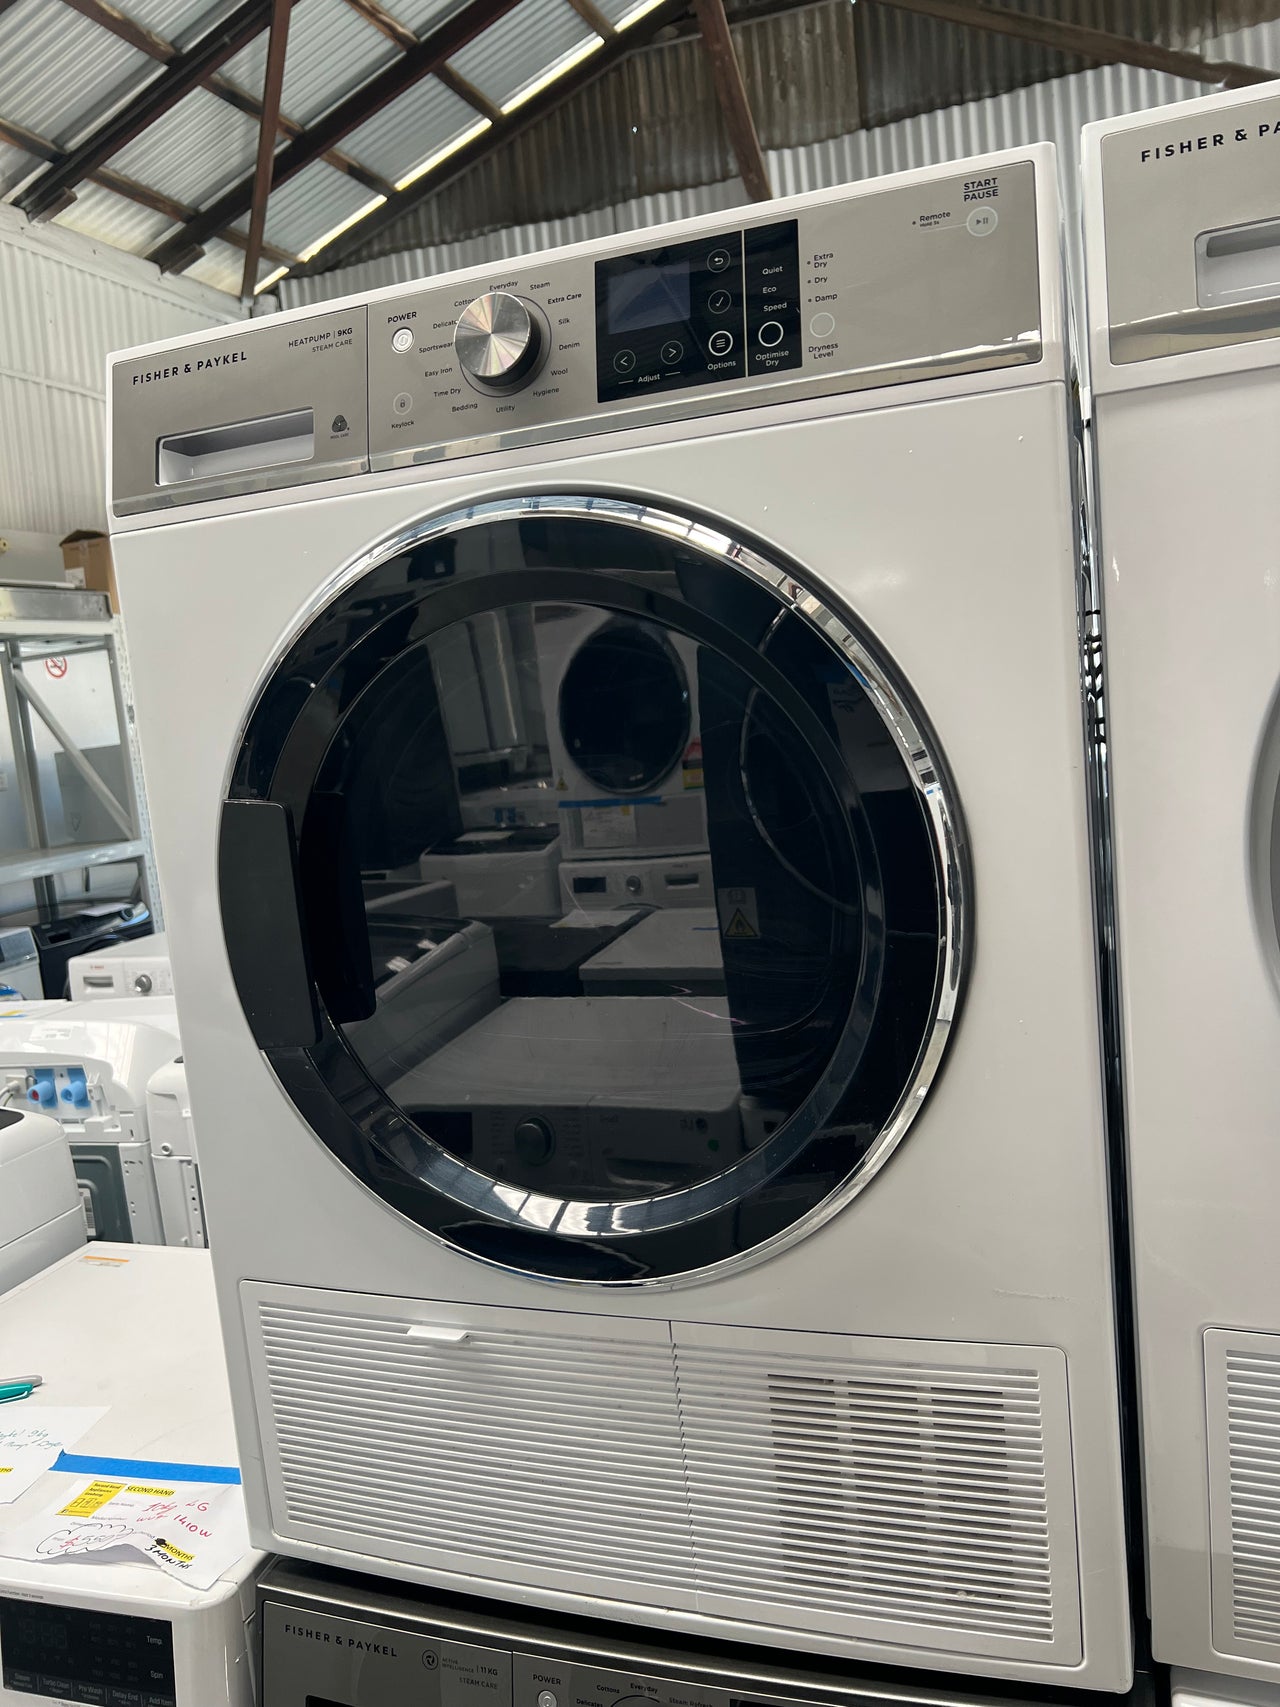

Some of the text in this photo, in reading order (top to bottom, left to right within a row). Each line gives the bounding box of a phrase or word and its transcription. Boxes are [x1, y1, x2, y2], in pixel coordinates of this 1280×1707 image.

[1141, 134, 1224, 162] FISHER
[1235, 129, 1248, 142] &
[964, 178, 998, 190] START
[964, 189, 999, 202] PAUSE
[920, 212, 951, 222] Remote
[814, 252, 834, 261] Extra
[814, 260, 828, 269] Dry
[762, 265, 784, 276] Quiet
[815, 275, 828, 284] Dry
[489, 280, 519, 292] Everyday
[529, 282, 551, 291] Steam
[762, 285, 777, 294] Eco
[454, 298, 478, 307] Cotton
[547, 293, 582, 305] Extra Care
[815, 292, 838, 303] Damp
[763, 302, 788, 313] Speed
[387, 312, 418, 324] POWER
[558, 317, 571, 326] Silk
[288, 327, 353, 348] HEATPUMP 9KG
[312, 338, 353, 353] STEAM CARE
[418, 342, 454, 354] Sportswear
[559, 342, 580, 351] Denim
[808, 342, 839, 354] Dryness
[756, 349, 790, 362] Optimise
[814, 350, 834, 360] Level
[132, 351, 248, 386] FISHER & PAYKEL
[707, 360, 737, 371] Options
[766, 359, 780, 368] Dry
[424, 367, 453, 379] Easy Iron
[551, 368, 569, 376] Wool
[638, 373, 661, 384] Adjust
[434, 388, 462, 398] Time Dry
[532, 387, 560, 398] Hygiene
[452, 402, 478, 413] Bedding
[496, 404, 516, 414] Utility
[391, 420, 415, 430] Keylock
[127, 1486, 154, 1494] SECOND
[166, 1544, 194, 1560] MONTHS
[152, 1549, 193, 1569] MONTHS
[285, 1624, 398, 1657] FISHER & PAYKEL
[150, 1670, 164, 1680] Spin
[533, 1674, 562, 1686] POWER
[459, 1677, 498, 1690] STEAM CARE
[596, 1684, 620, 1694] Cottons
[630, 1683, 658, 1694] Everyday
[112, 1690, 139, 1701] Delay End
